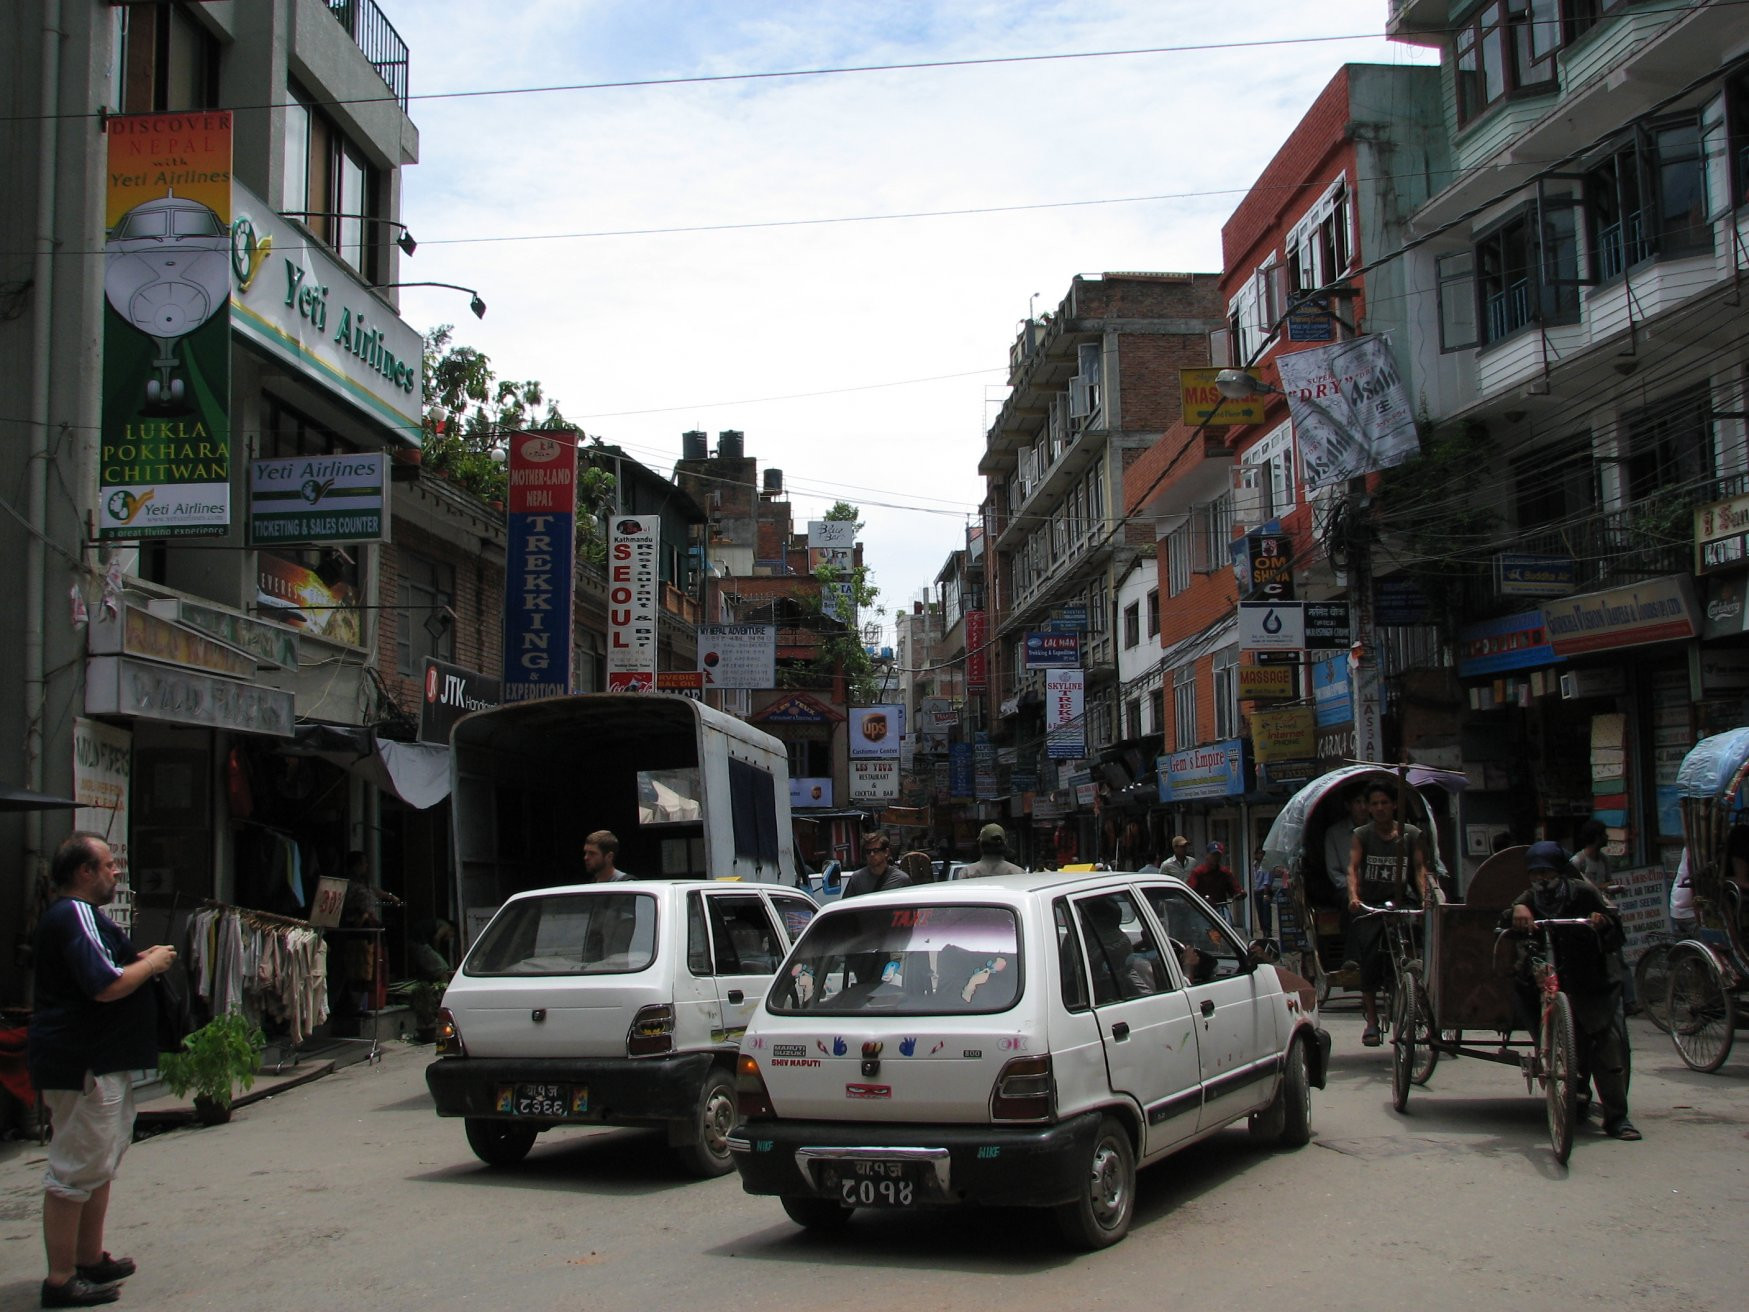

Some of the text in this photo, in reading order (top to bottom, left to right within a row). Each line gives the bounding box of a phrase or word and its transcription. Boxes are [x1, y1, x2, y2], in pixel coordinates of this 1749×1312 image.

[112, 115, 231, 135] DISCOVER
[129, 136, 217, 156] NEPAL
[111, 170, 230, 188] Yeti Airlines
[285, 258, 415, 393] Yeti Airlines
[125, 421, 208, 440] LUKLA
[103, 442, 230, 462] POKHARA
[104, 463, 228, 483] CHITWAN
[256, 462, 376, 480] Yeti Airlines
[511, 468, 571, 486] MOTHER-LAND
[526, 490, 553, 507] NEPAL
[145, 501, 225, 516] Yeti Airlines
[254, 516, 379, 537] TICKETING & SALES COUNTER
[614, 536, 653, 544] Kathmandu
[521, 515, 555, 670] TREKKING
[611, 543, 632, 649] SEOUL
[709, 626, 727, 636] NEPAL
[728, 626, 766, 636] ADVENTURE
[529, 673, 540, 681] &
[1047, 682, 1083, 690] SKYLINE
[1240, 670, 1290, 685] MASSAGE
[440, 674, 467, 709] JTK
[505, 682, 565, 700] EXPEDITION
[1057, 689, 1073, 723] TREKS
[863, 722, 886, 740] ups
[852, 747, 898, 756] Customer Center
[1195, 745, 1225, 774] Empire
[855, 763, 893, 772] LES YEUX
